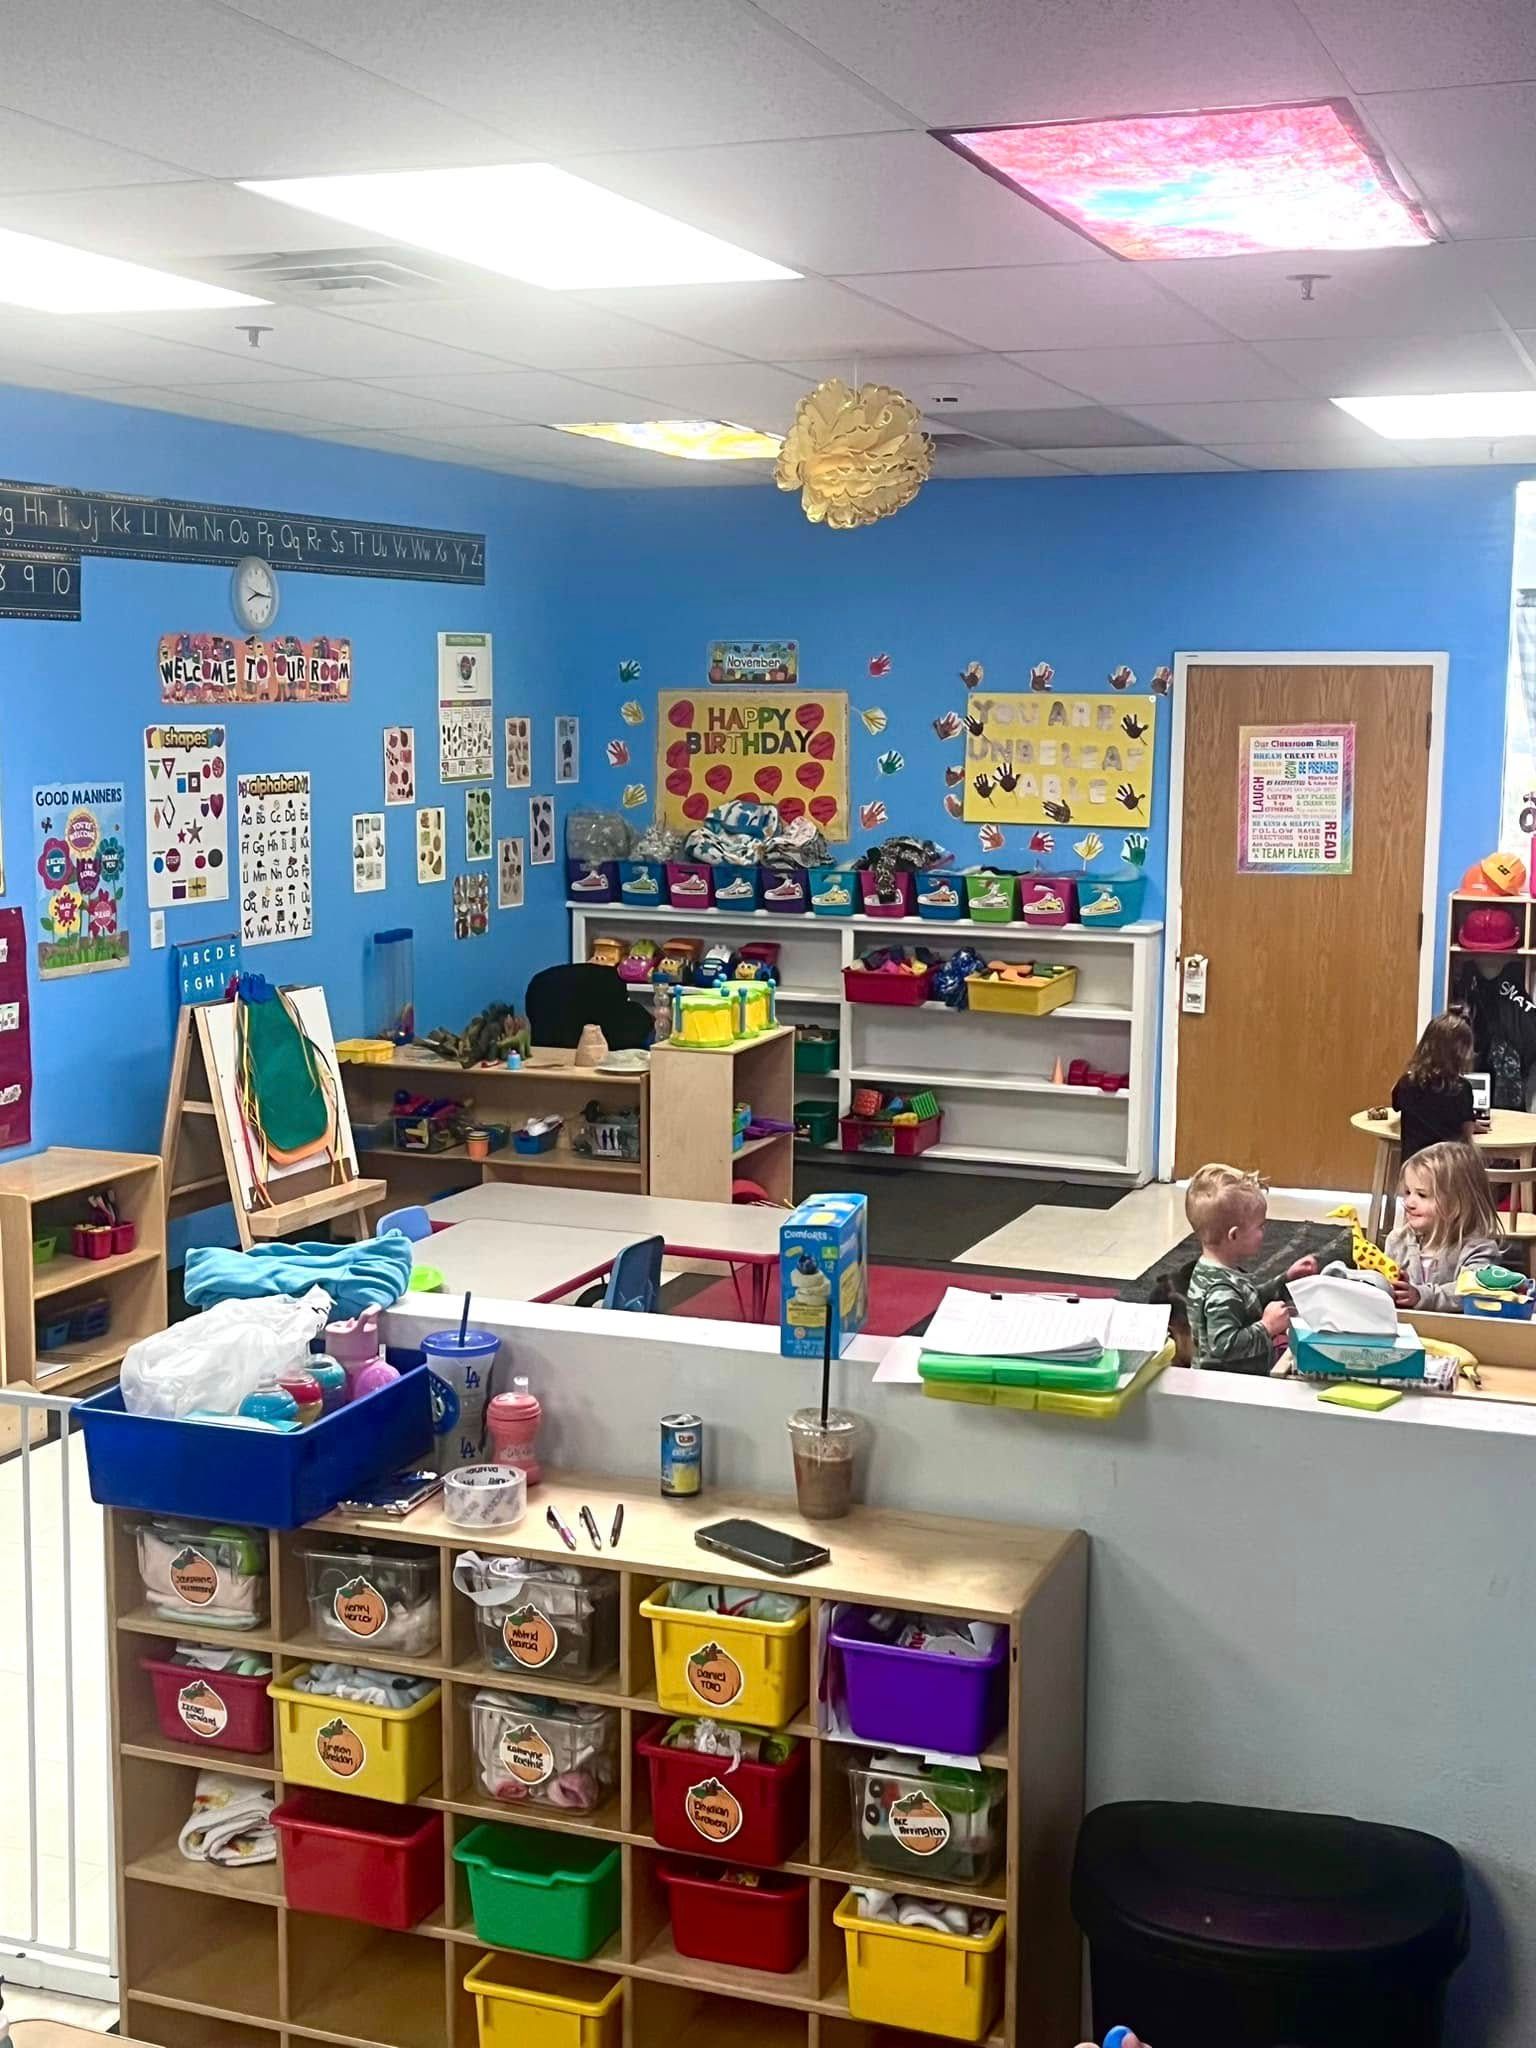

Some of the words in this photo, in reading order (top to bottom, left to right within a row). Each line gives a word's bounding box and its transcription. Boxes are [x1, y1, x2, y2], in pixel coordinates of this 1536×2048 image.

[24, 496, 47, 527] Hh
[58, 500, 69, 527] Ii
[81, 504, 98, 545] Jj
[110, 506, 131, 535] Kk
[169, 512, 198, 539] Mm
[204, 516, 223, 542] Nn
[230, 519, 249, 545] Oo
[257, 521, 274, 558] Pp
[280, 524, 302, 560] Qq
[307, 527, 322, 552] Rr
[331, 530, 344, 553] Ss
[372, 534, 388, 557] Uu
[455, 543, 466, 575] Yy
[472, 544, 483, 566] Zz
[24, 565, 35, 592] 9
[53, 568, 71, 595] 10
[160, 658, 237, 686] WELCOME
[246, 657, 269, 681] TO
[274, 653, 305, 682] OUR
[310, 661, 350, 681] ROOM
[727, 655, 781, 669] November
[708, 707, 791, 732] HAPPY
[1048, 701, 1115, 731] ARE
[165, 727, 208, 751] shapes
[686, 730, 814, 756] BIRTHDAY
[1271, 740, 1314, 748] Classroom
[36, 791, 69, 807] GOOD
[71, 788, 122, 805] MANNERS
[250, 775, 300, 800] alphabet
[1252, 776, 1264, 813] LAUGH
[241, 813, 253, 826] Aa
[270, 810, 281, 823] Cc
[253, 841, 265, 857] Gg
[1324, 821, 1337, 859] READ
[1262, 848, 1285, 859] TEAM
[1287, 848, 1321, 859] PLAYER
[182, 954, 189, 969] A
[193, 951, 200, 966] B
[203, 948, 211, 963] C
[216, 946, 224, 960] D
[230, 944, 236, 958] E
[184, 979, 189, 993] F
[195, 977, 203, 990] G
[205, 974, 214, 989] H
[220, 972, 225, 985] I
[465, 1365, 481, 1389] LA
[460, 1436, 476, 1459] LA
[697, 1668, 726, 1682] Daniel
